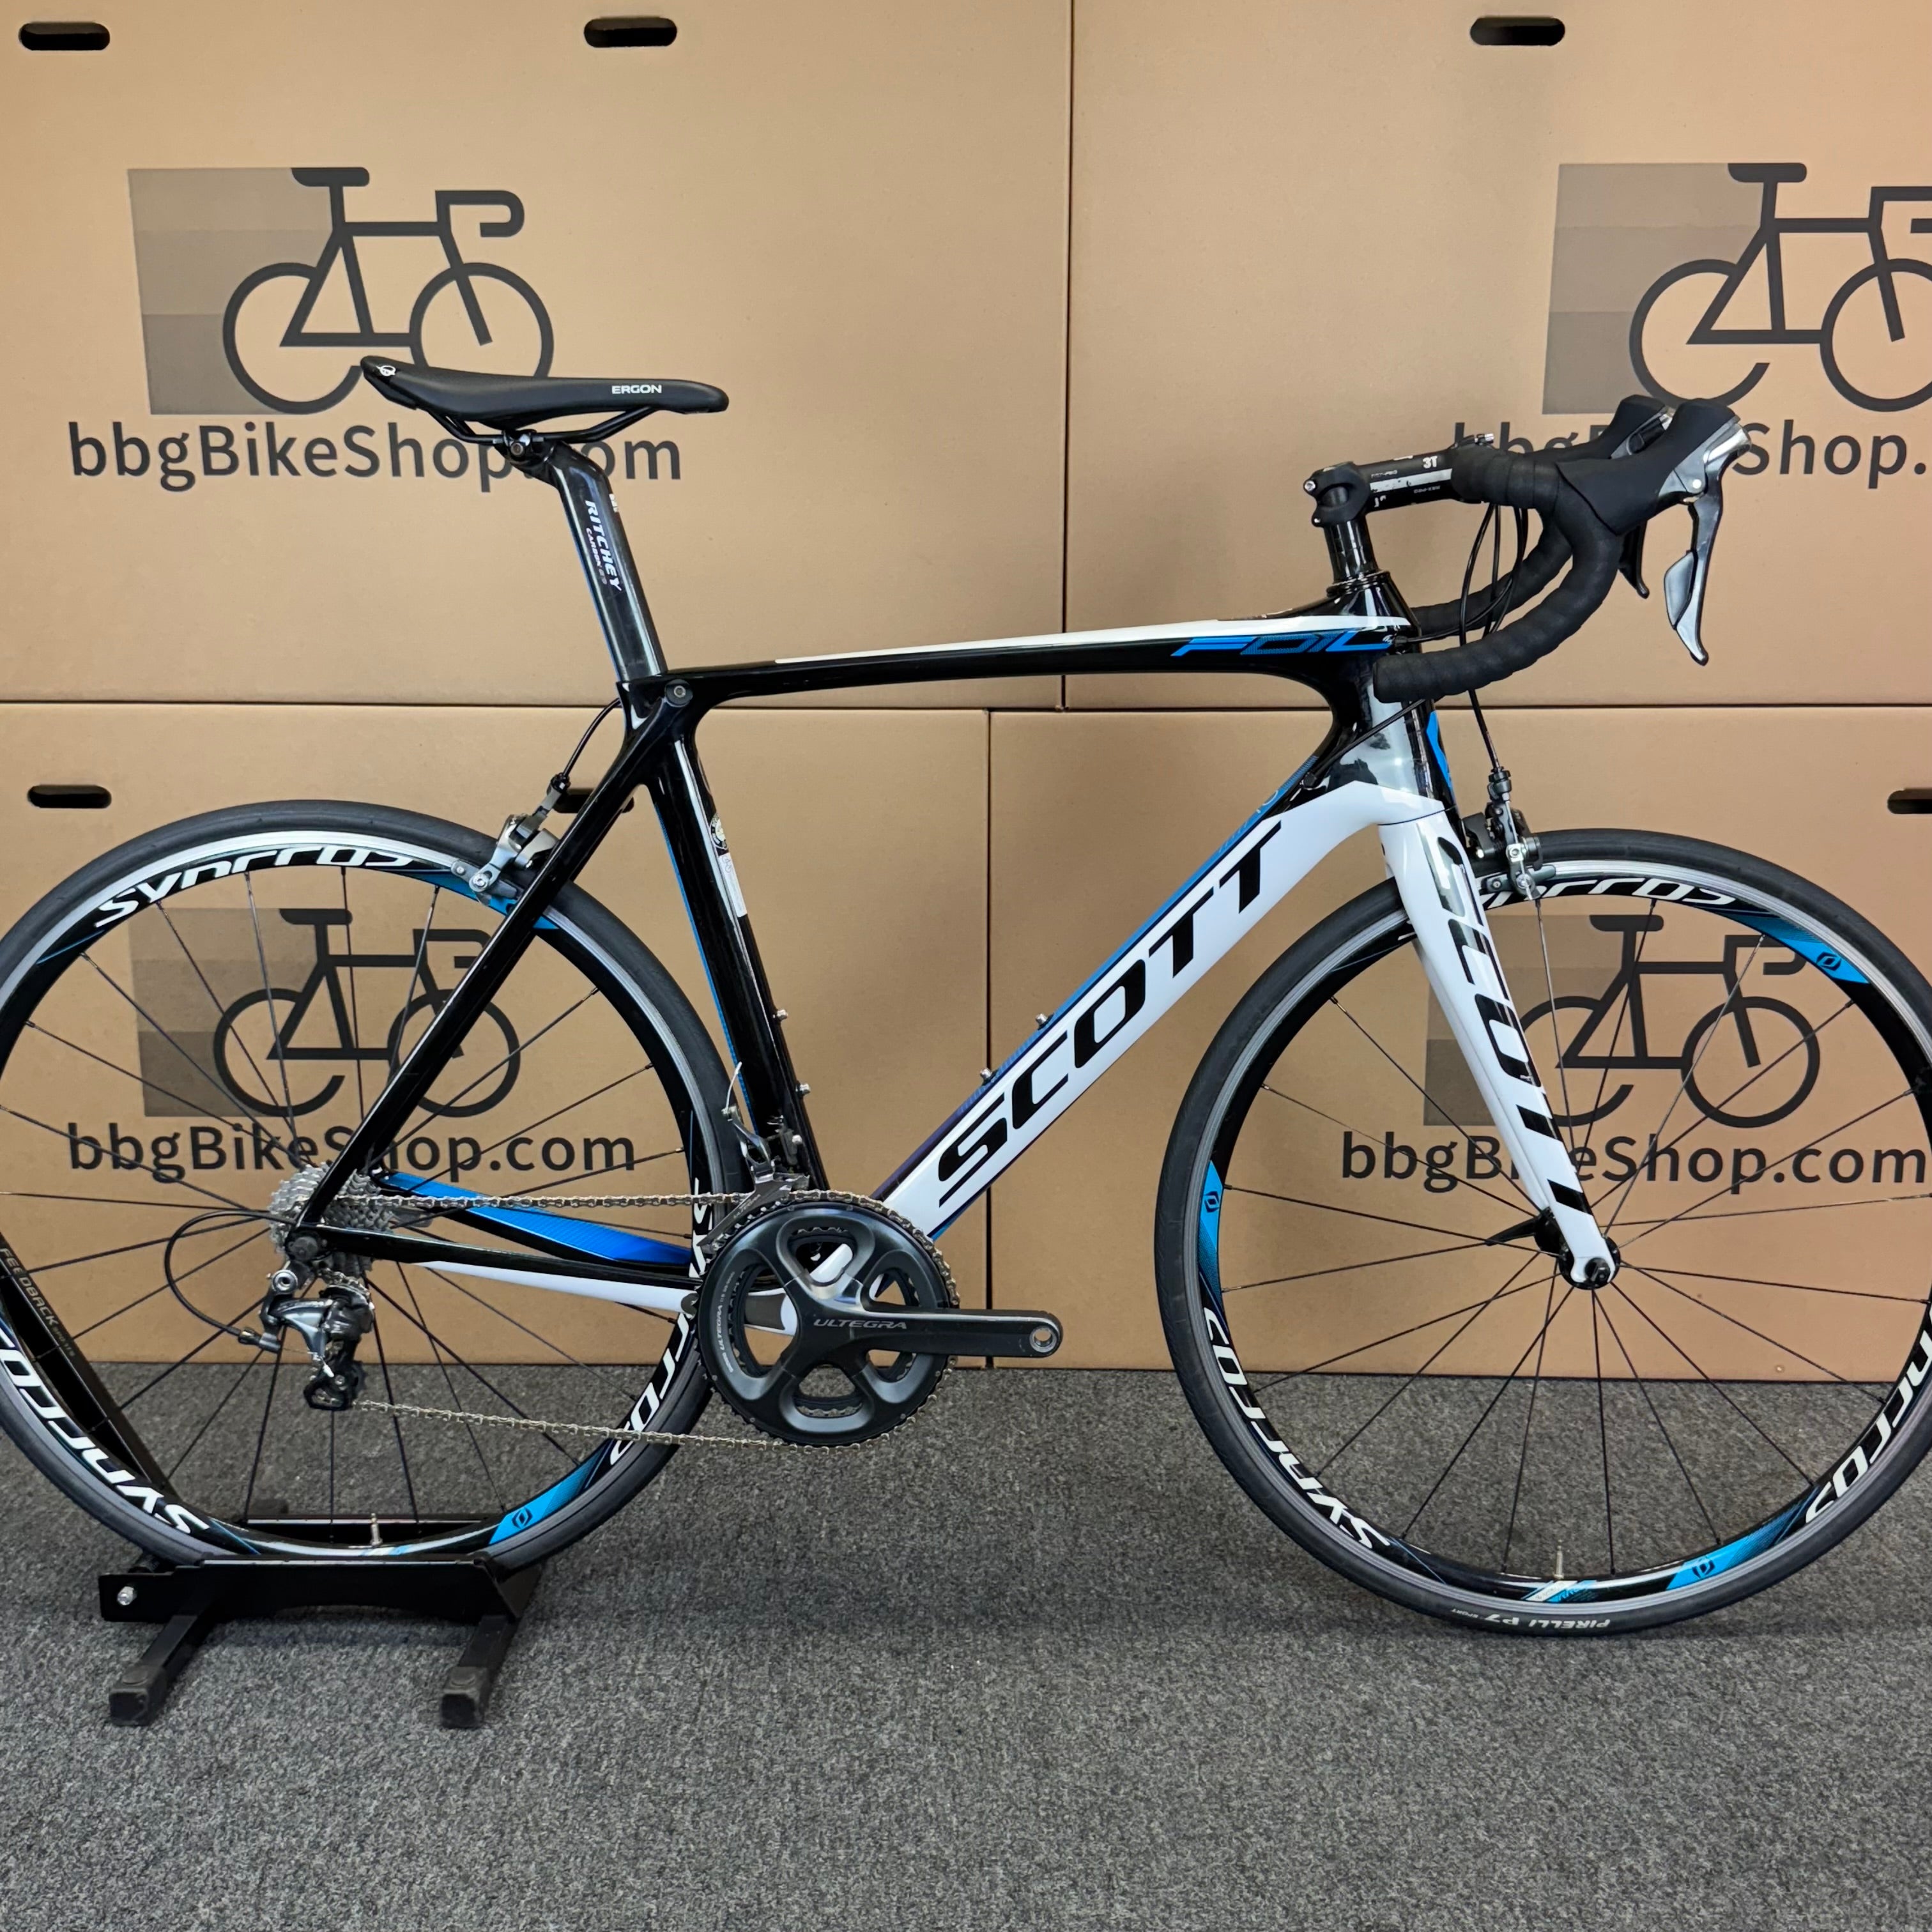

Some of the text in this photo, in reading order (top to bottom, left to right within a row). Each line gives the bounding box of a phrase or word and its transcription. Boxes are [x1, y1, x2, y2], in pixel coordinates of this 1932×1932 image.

[611, 385, 662, 394] ERGON
[1423, 456, 1438, 469] 3T
[585, 500, 622, 591] RITCHEY
[586, 527, 602, 567] CARBON
[1170, 628, 1393, 657] FOIL
[938, 820, 1282, 1208] SCOTT
[716, 1305, 725, 1351] ULTEGRA
[813, 1319, 907, 1330] ULTEGRA
[1451, 1608, 1611, 1629] PIRELLI P7 SPORT
